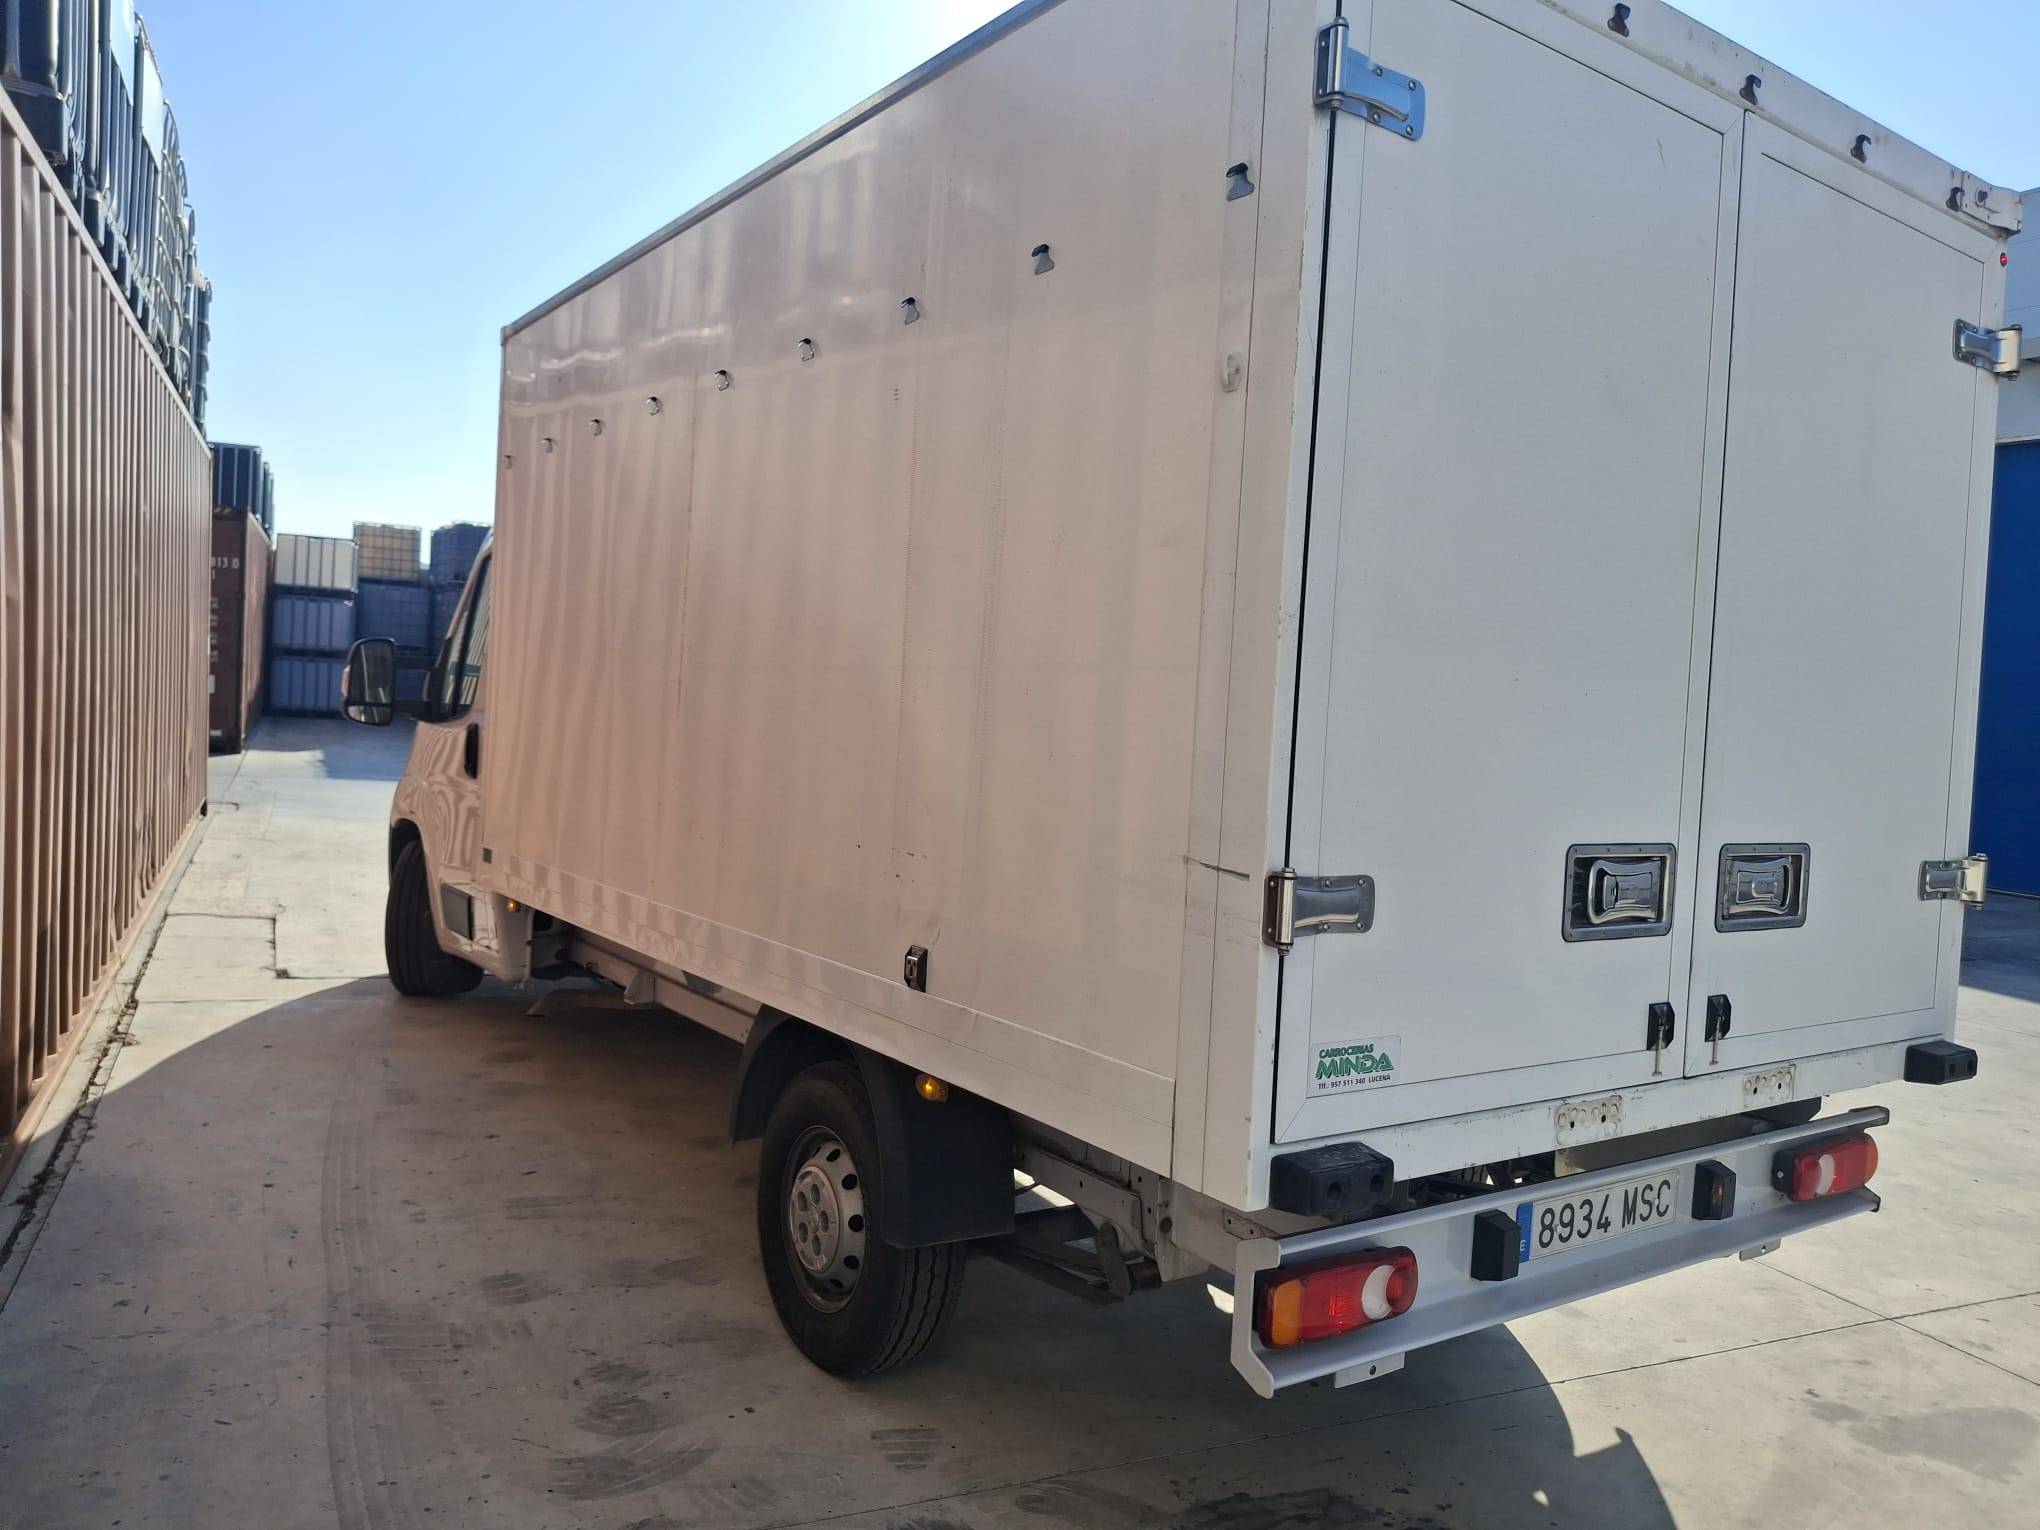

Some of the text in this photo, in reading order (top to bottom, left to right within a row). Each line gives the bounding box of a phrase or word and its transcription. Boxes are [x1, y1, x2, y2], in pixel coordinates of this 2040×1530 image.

[1315, 1052, 1394, 1080] MINDA
[1368, 1074, 1391, 1083] LUCENA
[1538, 1180, 1671, 1249] 8934 MSC
